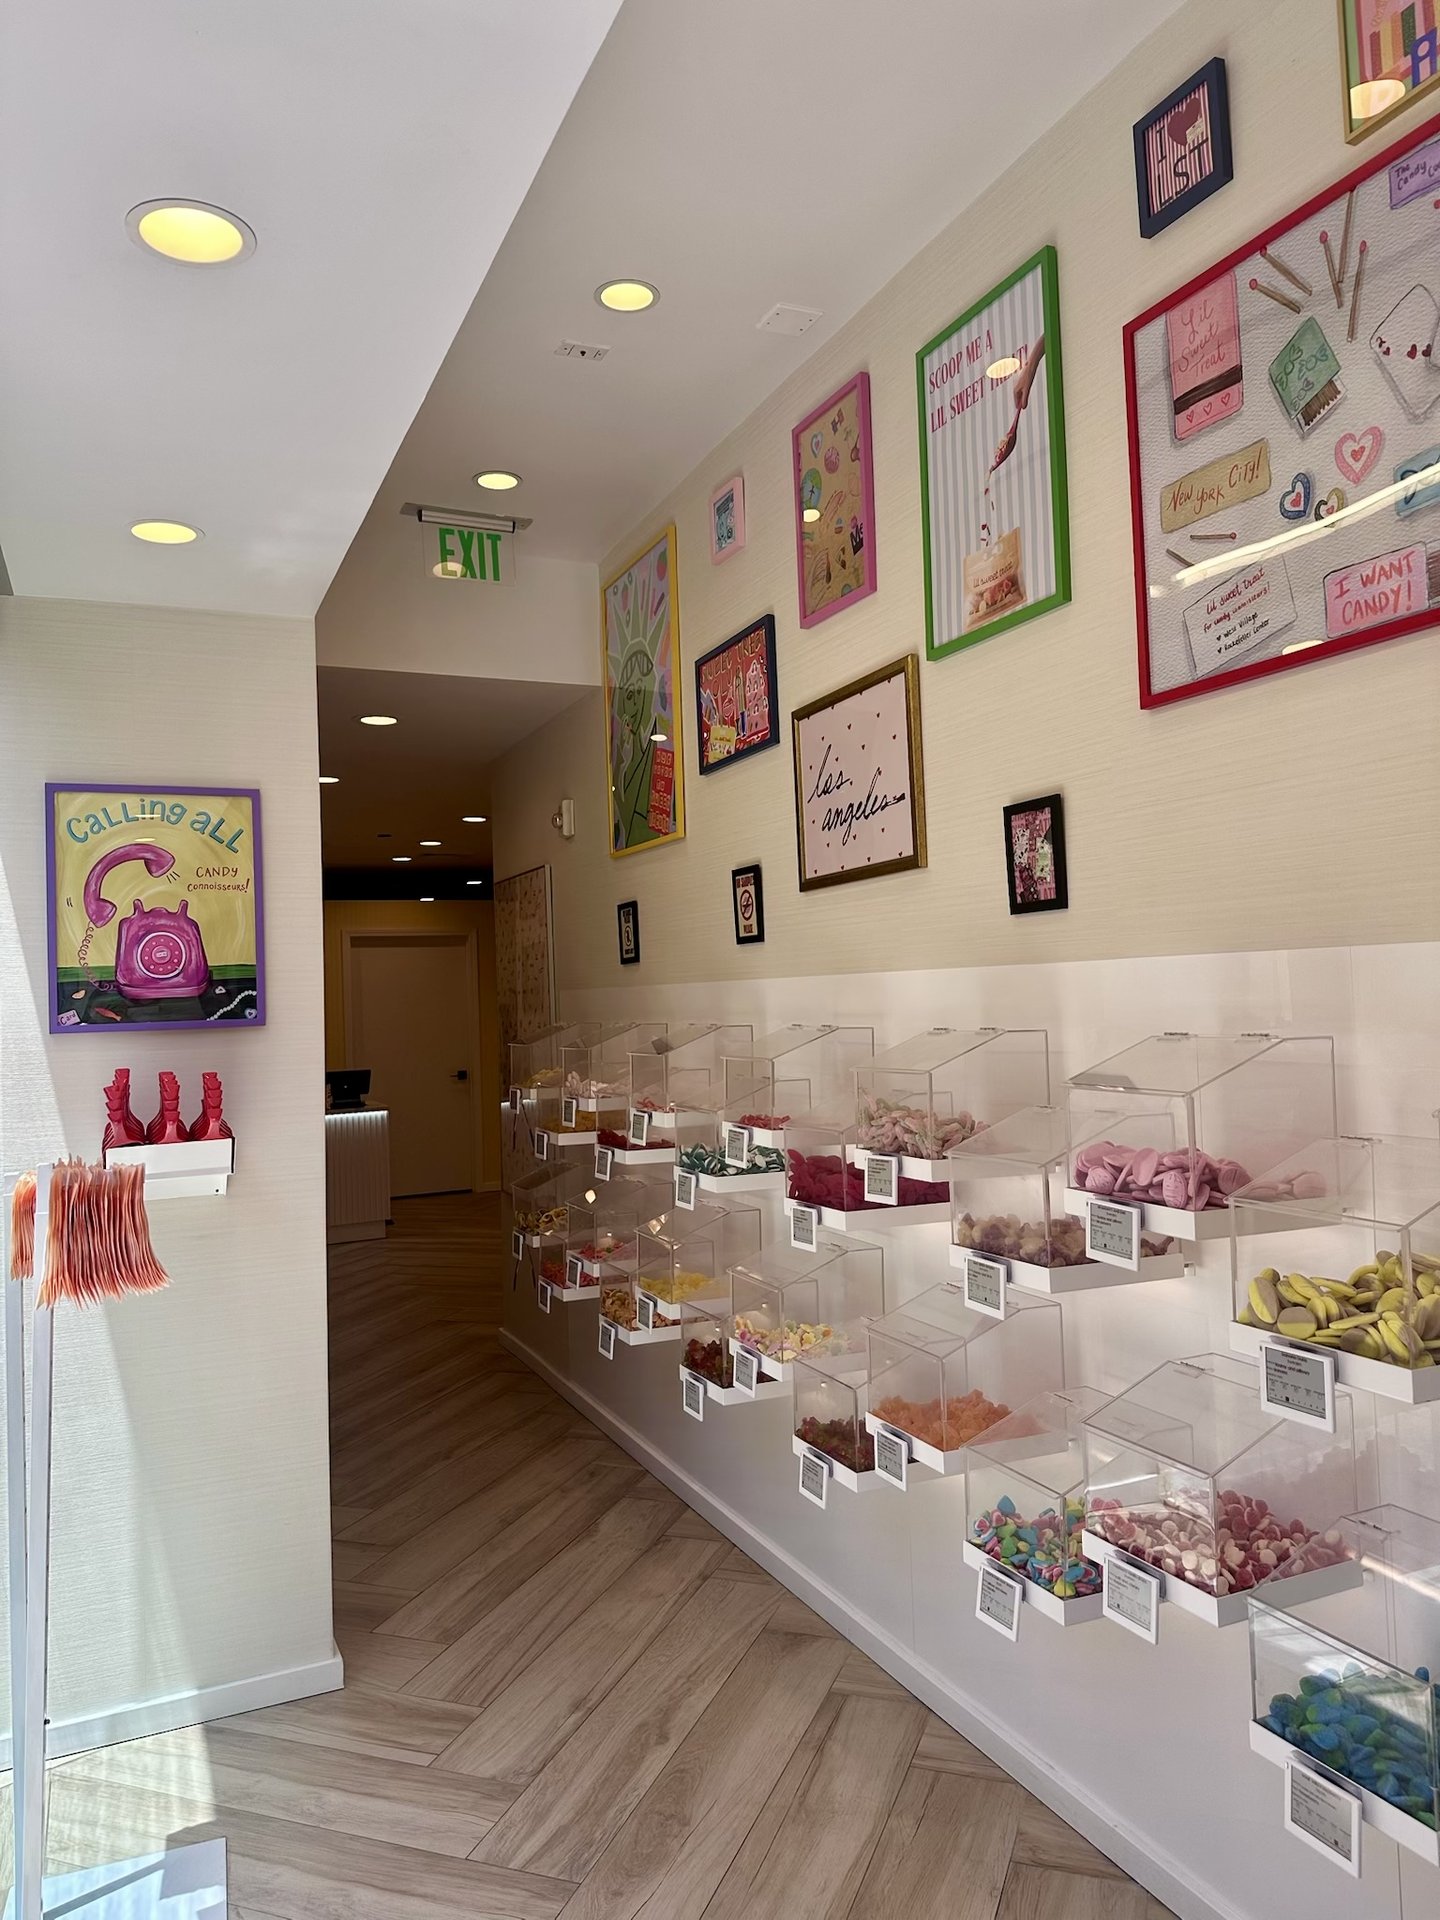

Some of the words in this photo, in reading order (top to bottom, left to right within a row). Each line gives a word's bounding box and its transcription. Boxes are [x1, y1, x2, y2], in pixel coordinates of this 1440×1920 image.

[929, 350, 963, 394] SCOOP
[966, 336, 982, 367] ME
[985, 329, 993, 353] A
[1189, 339, 1226, 377] Treat
[931, 405, 947, 433] LIL
[949, 375, 985, 420] SWEET
[438, 527, 502, 582] EXIT
[1334, 572, 1353, 600] I
[1360, 550, 1416, 588] WANT
[1342, 579, 1412, 626] CANDY!
[196, 866, 239, 878] CANDY
